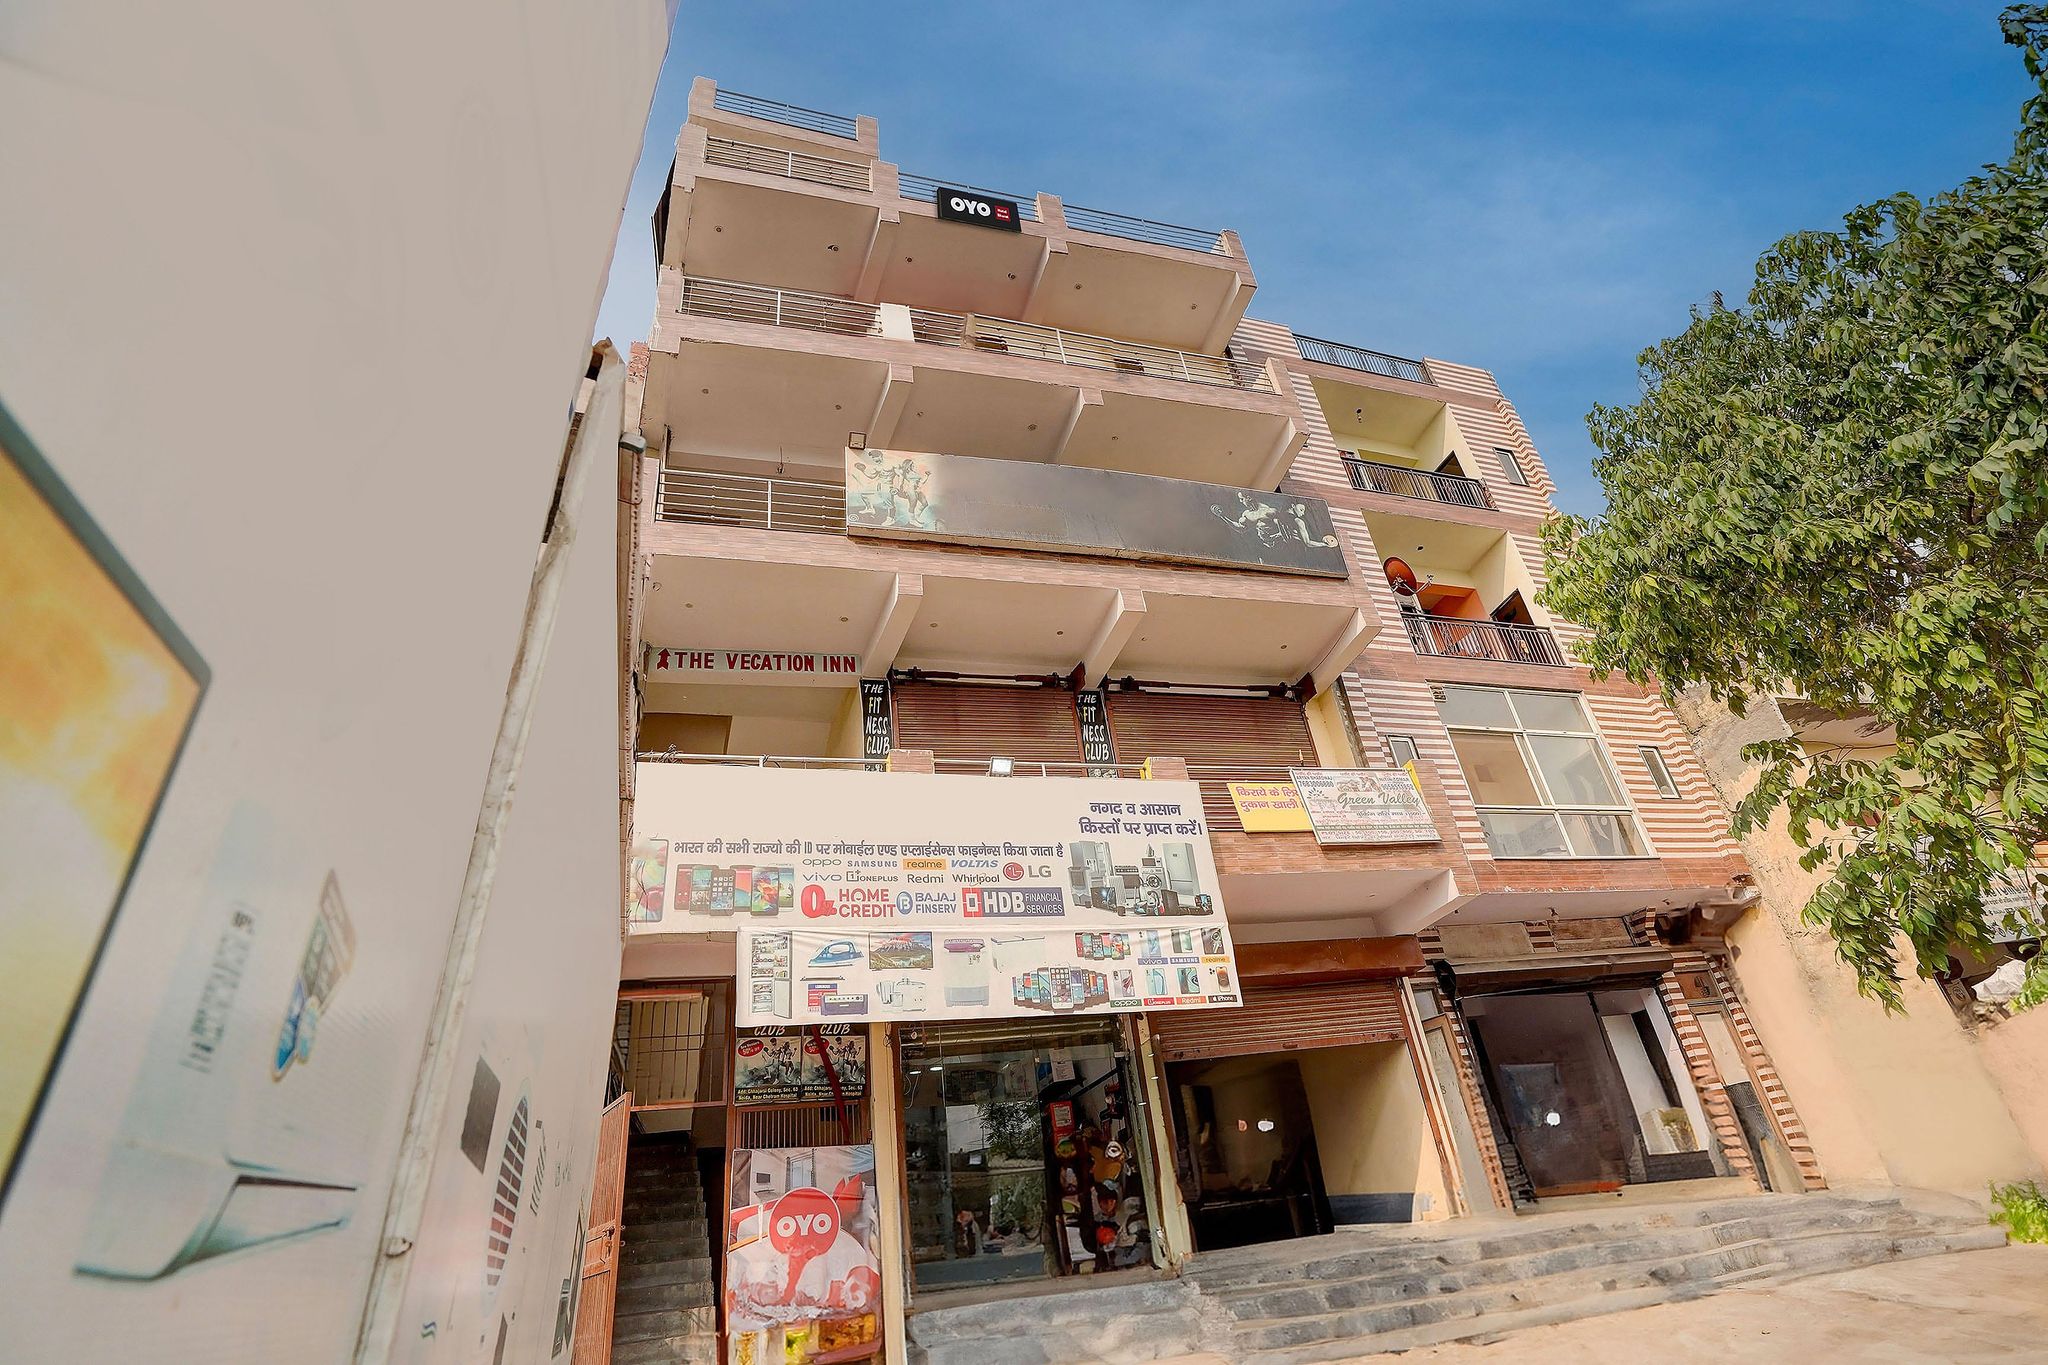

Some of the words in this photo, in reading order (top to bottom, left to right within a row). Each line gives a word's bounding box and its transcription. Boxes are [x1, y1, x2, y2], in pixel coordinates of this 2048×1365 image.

[950, 197, 991, 217] OYO
[674, 652, 715, 669] THE
[726, 653, 814, 671] VECATION
[823, 656, 856, 673] INN
[864, 684, 884, 694] THE
[868, 697, 882, 714] FIT
[1077, 694, 1097, 704] THE
[1083, 706, 1096, 722] FIT
[866, 716, 888, 735] NESS
[1083, 724, 1105, 742] NESS
[866, 736, 890, 755] CLUB
[1085, 743, 1110, 761] CLUB
[1268, 787, 1280, 796] के
[1239, 800, 1270, 812] दुकान
[1337, 793, 1375, 809] Green
[1378, 792, 1420, 807] Valley
[1089, 802, 1122, 815] नगद
[1126, 803, 1137, 815] व
[1140, 803, 1181, 815] आसान
[1079, 816, 1121, 834] किस्तों
[1123, 822, 1141, 834] पर
[1143, 822, 1172, 837] प्राप्त
[674, 842, 704, 853] भारत
[706, 838, 723, 854] की
[726, 838, 750, 854] सभी
[786, 839, 801, 854] की
[816, 843, 831, 855] पर
[877, 844, 898, 857] एण्ड
[1003, 842, 1028, 857] किया
[1029, 845, 1053, 857] जाता
[1055, 842, 1064, 858] है
[847, 860, 898, 868] SAMSUNG
[951, 860, 998, 868] VOLTAS
[907, 874, 944, 884] Redmi
[952, 873, 999, 886] Whirlpool
[1028, 865, 1051, 878] LG
[839, 888, 889, 902] HOME
[915, 892, 956, 902] BAJAJ
[983, 892, 1024, 913] HDB
[1025, 892, 1062, 902] FINANCIAL
[839, 904, 896, 918] CREDIT
[915, 903, 957, 914] FINSERV
[1026, 904, 1063, 914] SERVICES
[754, 1026, 786, 1036] CLUB
[820, 1024, 851, 1035] CLUB
[776, 1213, 832, 1238] OYO
